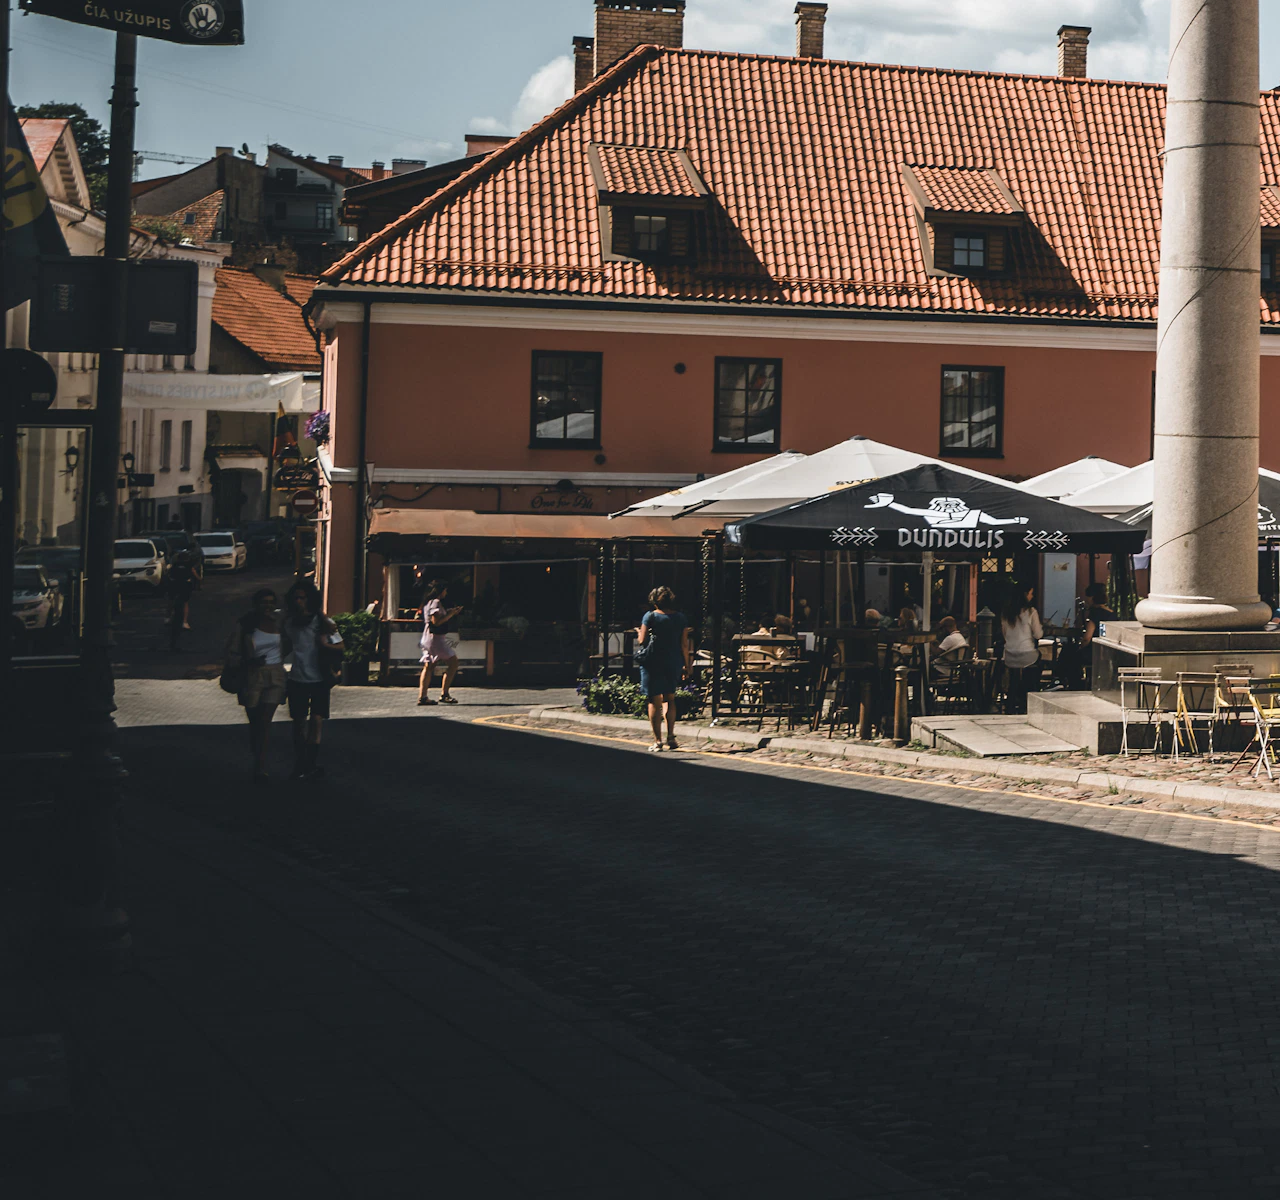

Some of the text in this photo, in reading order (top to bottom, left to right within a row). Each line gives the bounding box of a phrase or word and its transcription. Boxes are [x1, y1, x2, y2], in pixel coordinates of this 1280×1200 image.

[84, 0, 172, 31] ČIA UŽUPIS
[898, 528, 1004, 549] DUNDULIS
